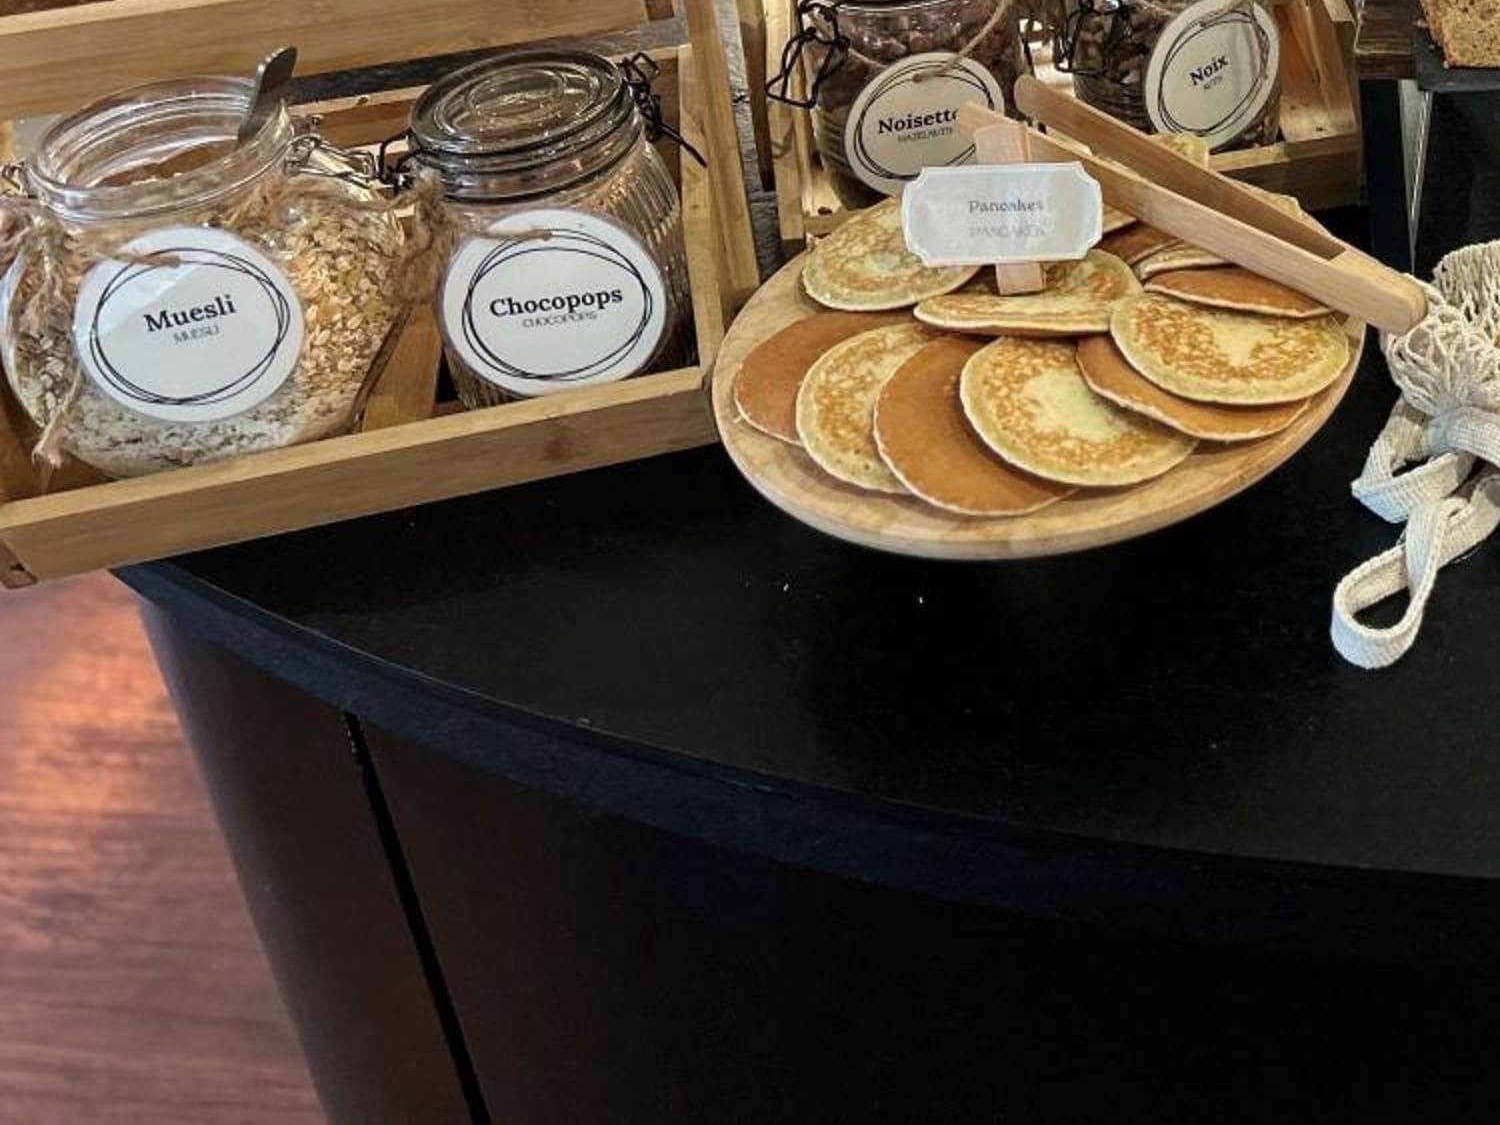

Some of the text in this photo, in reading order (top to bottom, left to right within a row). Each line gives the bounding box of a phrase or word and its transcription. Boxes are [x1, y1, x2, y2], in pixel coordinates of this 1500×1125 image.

[1190, 56, 1229, 86] Noix
[143, 294, 237, 332] Muesli
[490, 288, 623, 317] Chocopops
